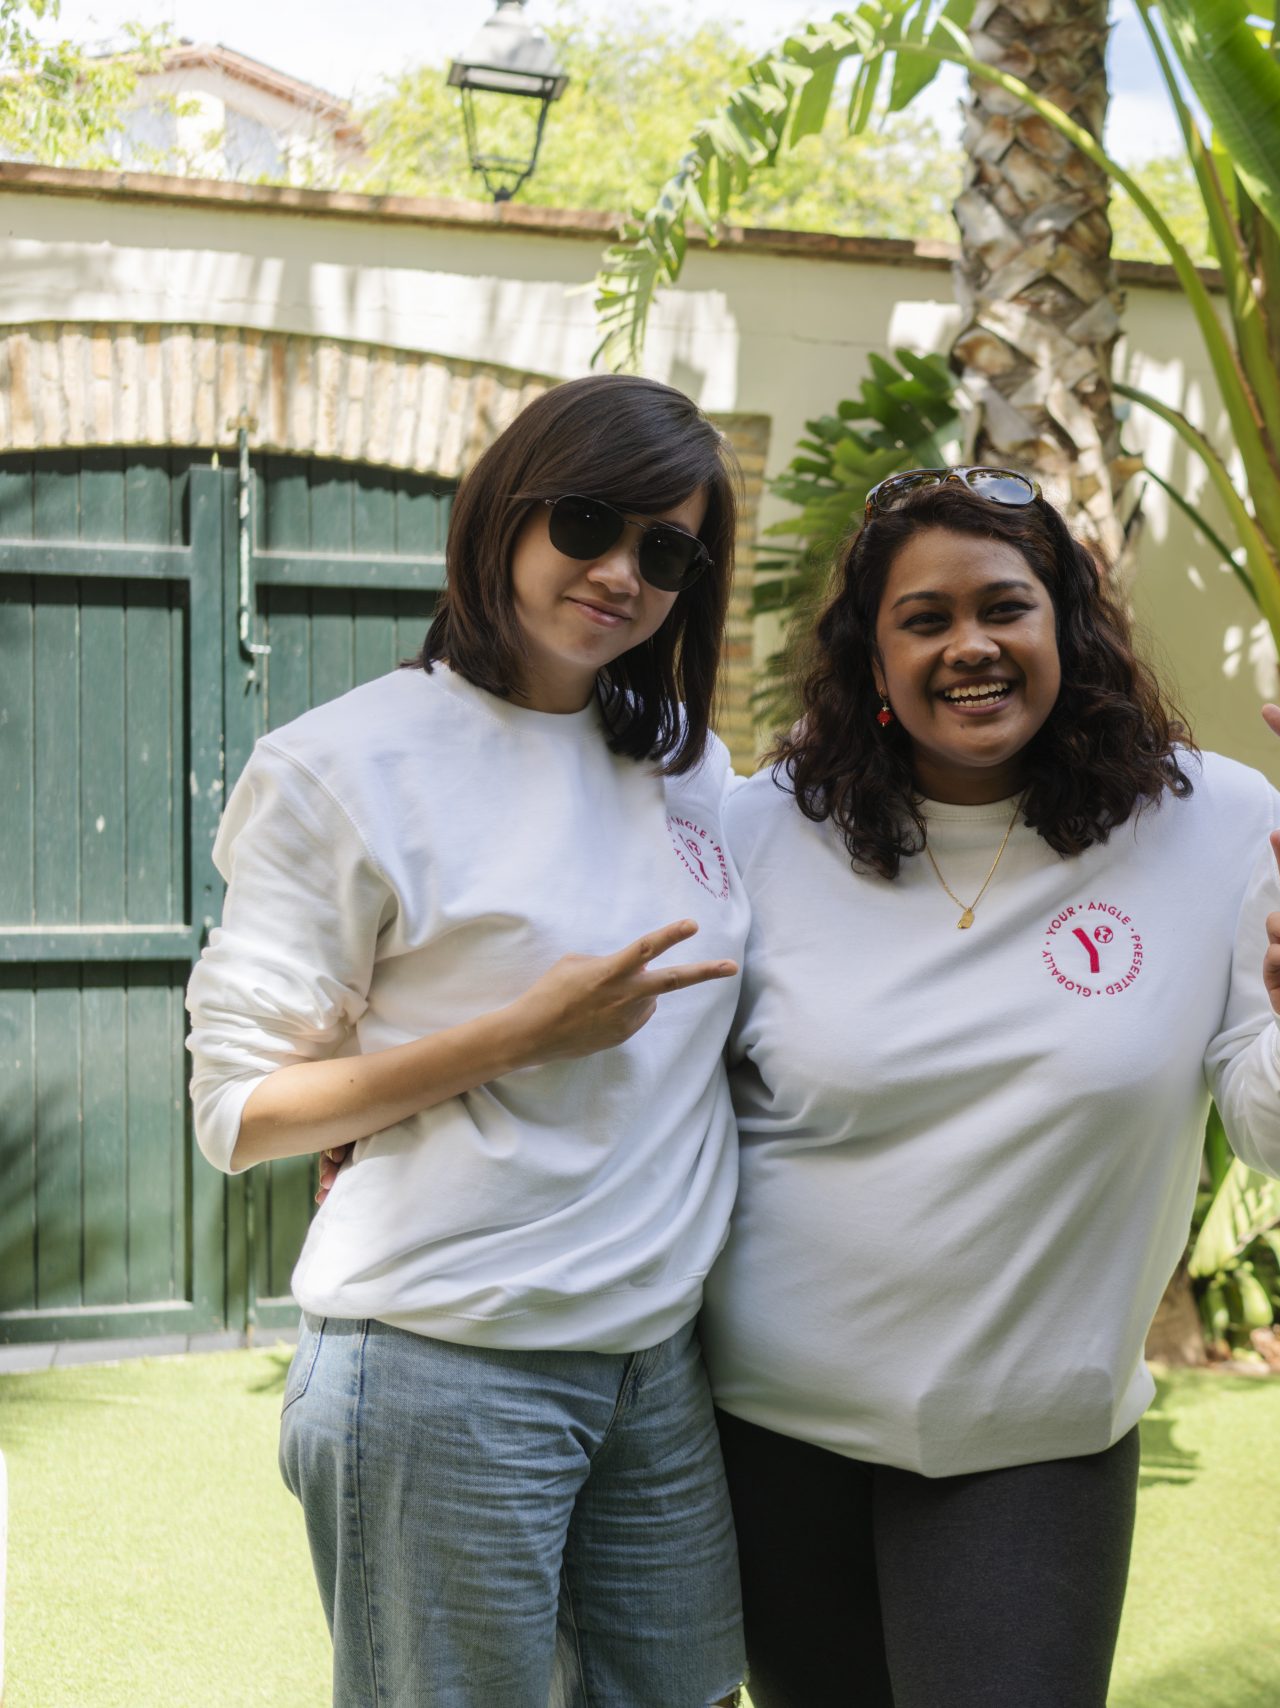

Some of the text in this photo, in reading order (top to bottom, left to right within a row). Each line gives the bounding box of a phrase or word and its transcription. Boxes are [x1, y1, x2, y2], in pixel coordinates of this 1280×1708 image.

[1042, 902, 1143, 998] YOUR ANGLE PRESENTED GLOBALLY
